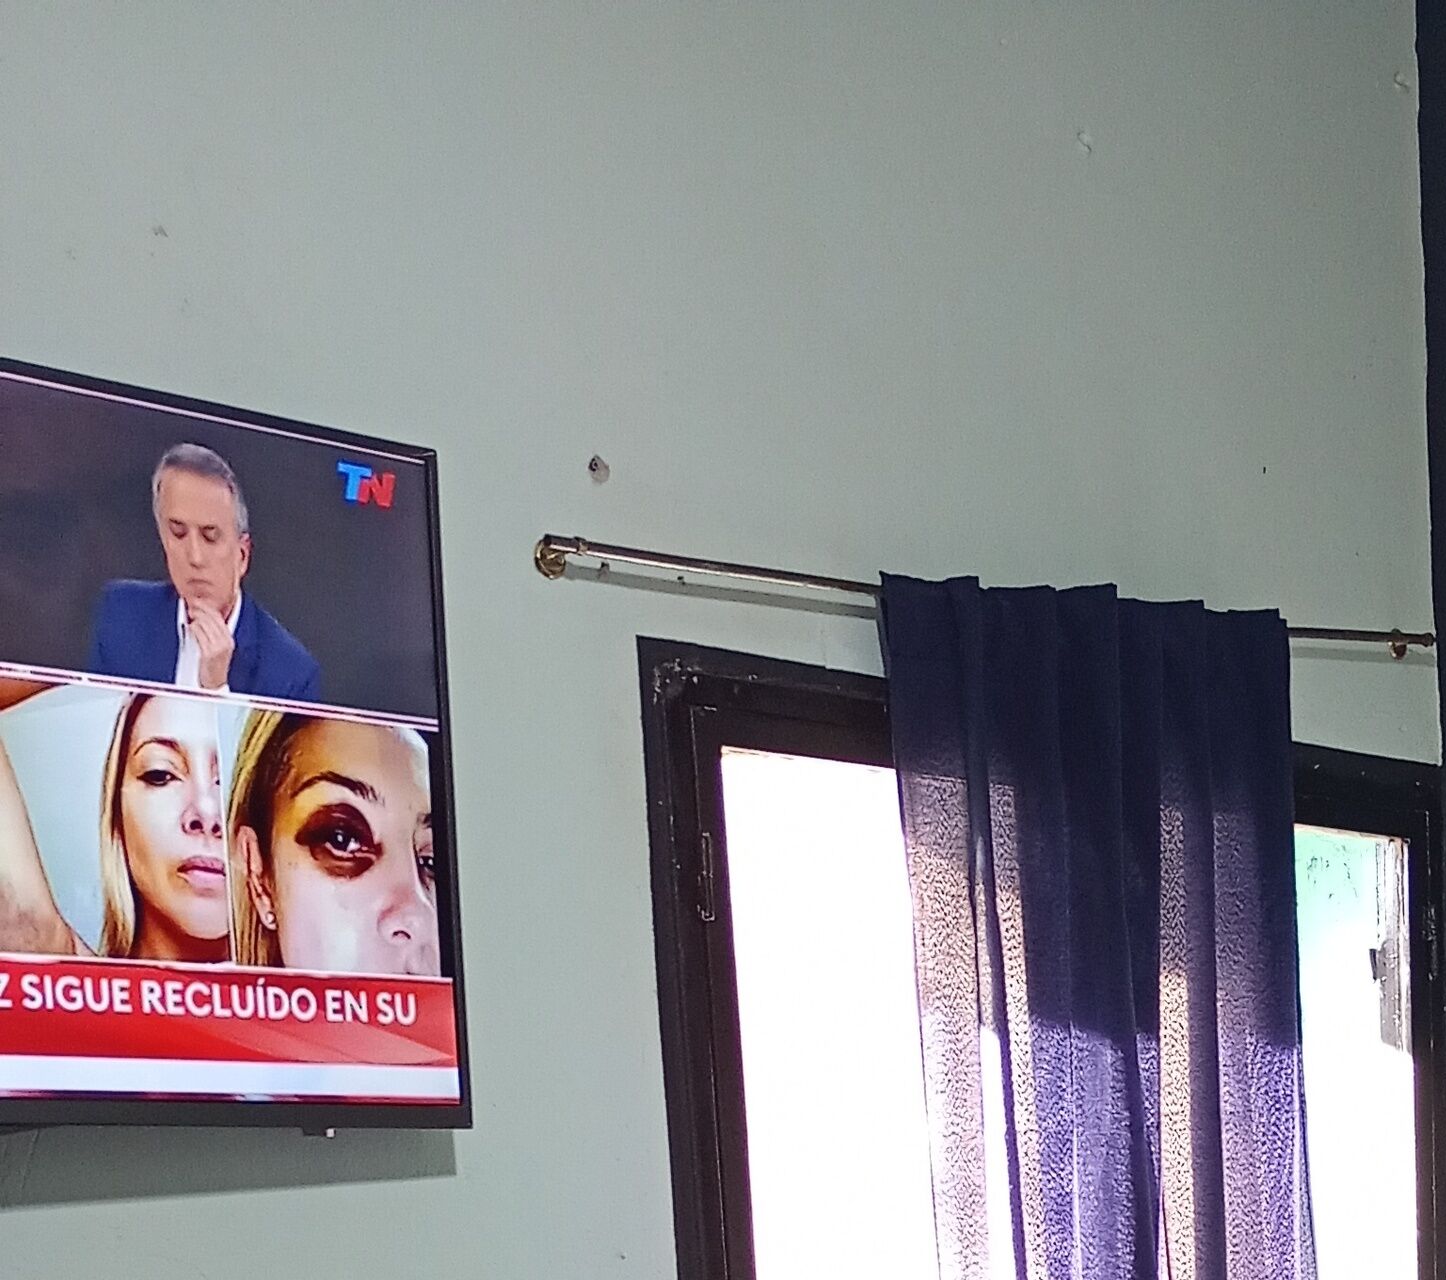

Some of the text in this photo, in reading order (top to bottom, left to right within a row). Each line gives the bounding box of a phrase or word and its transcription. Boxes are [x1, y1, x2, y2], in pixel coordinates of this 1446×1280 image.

[338, 461, 396, 508] TN
[21, 974, 132, 1014] SIGUE
[141, 976, 317, 1023] RECLUÍDO
[326, 994, 369, 1024] EN
[376, 992, 417, 1026] SU
